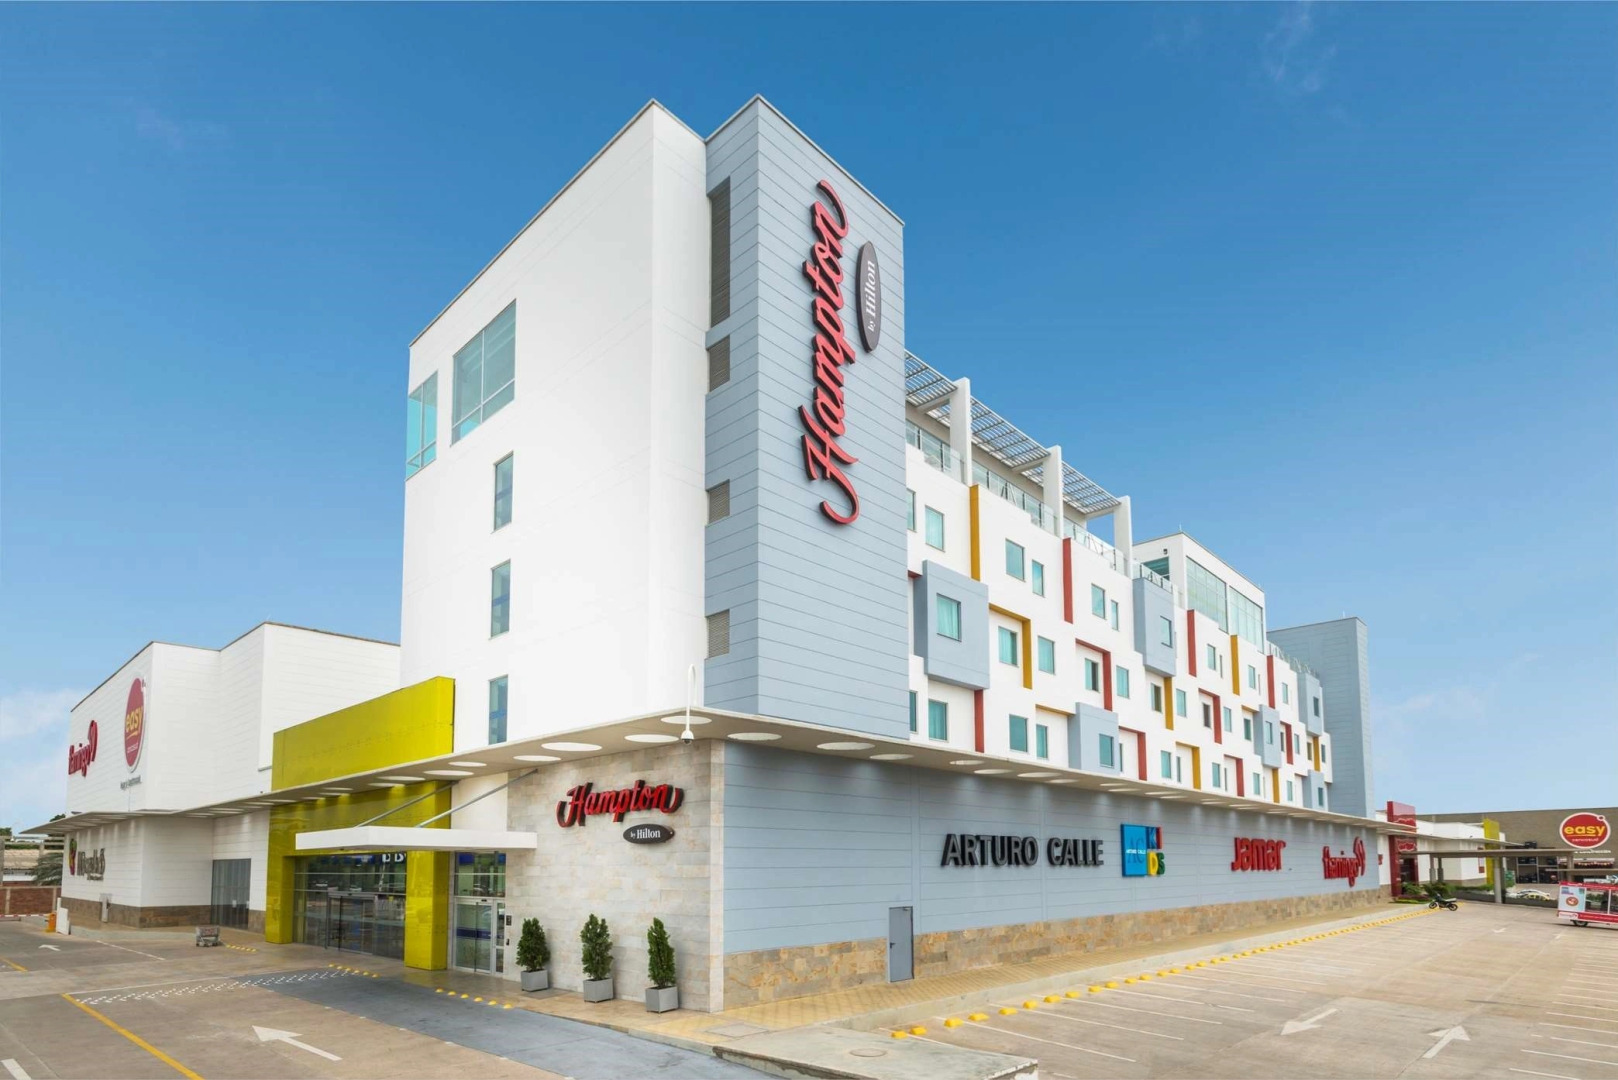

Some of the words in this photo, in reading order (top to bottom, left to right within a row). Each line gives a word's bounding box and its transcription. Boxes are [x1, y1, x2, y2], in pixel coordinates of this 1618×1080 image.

[864, 260, 876, 319] Hilton
[868, 320, 876, 333] by
[799, 180, 860, 525] Hampton
[126, 706, 143, 735] easy
[556, 779, 685, 828] Hampton
[630, 830, 636, 839] by
[636, 827, 661, 839] Hilton
[1564, 825, 1606, 837] easy
[941, 833, 1040, 867] ARTURO
[1046, 837, 1104, 867] CALLE
[1322, 837, 1366, 887] flamingo
